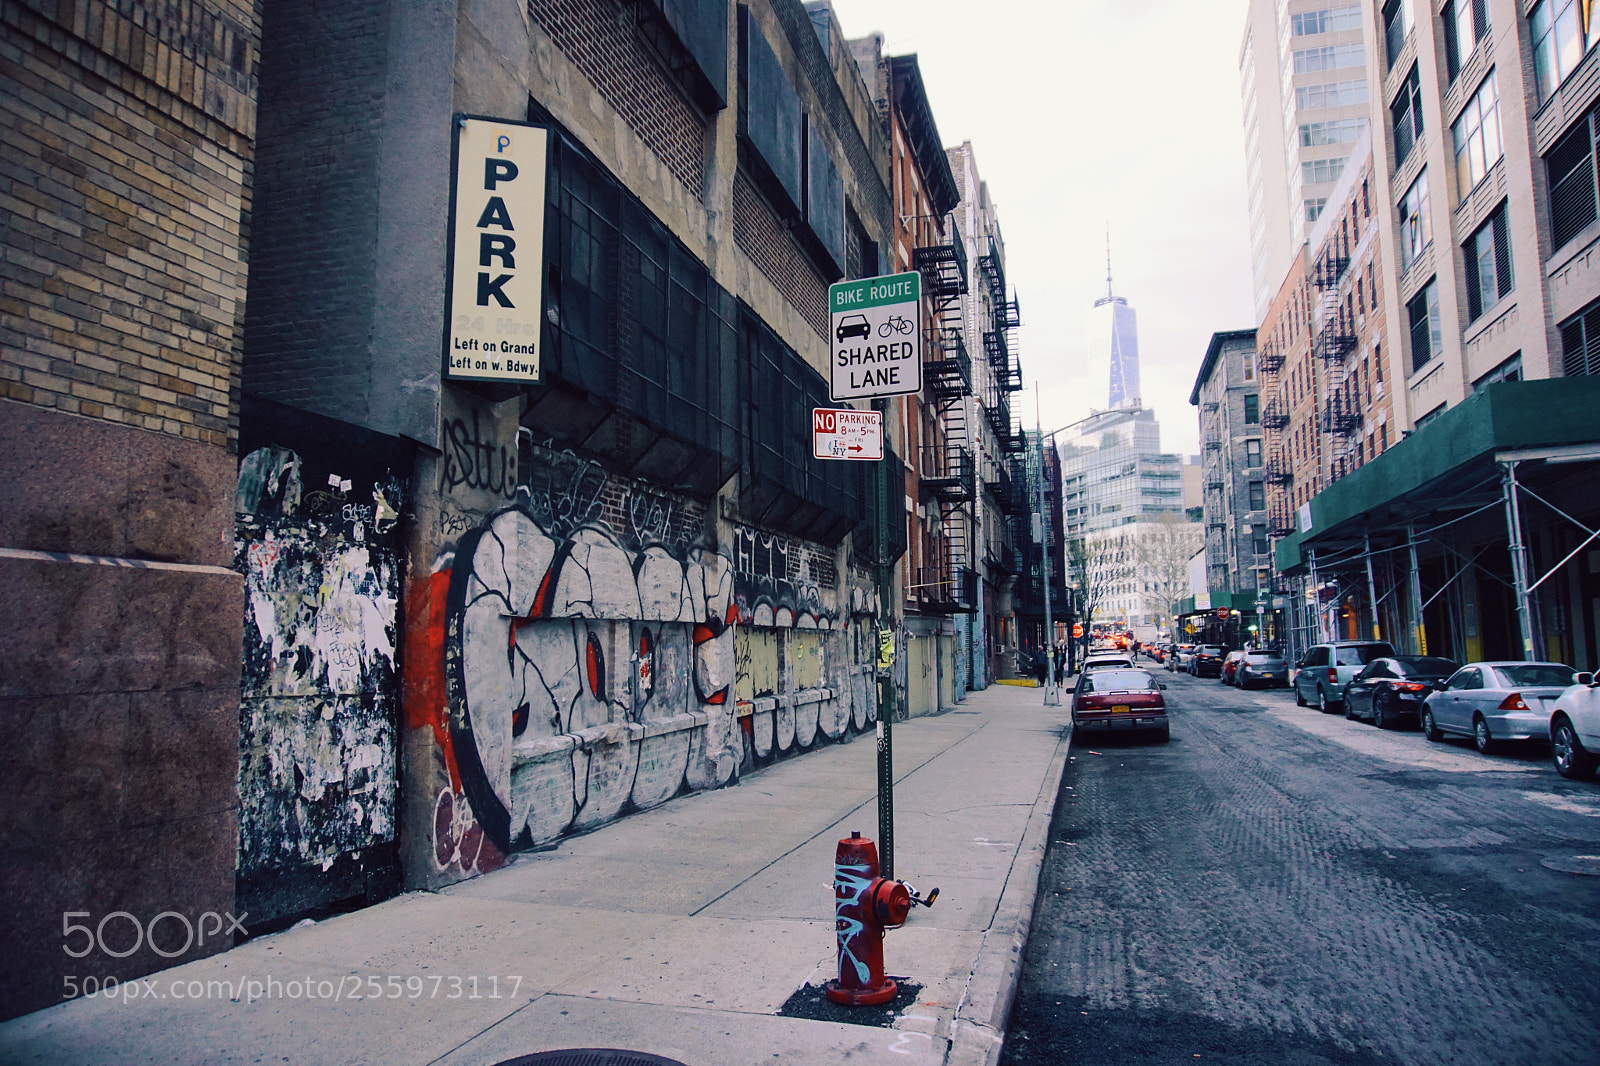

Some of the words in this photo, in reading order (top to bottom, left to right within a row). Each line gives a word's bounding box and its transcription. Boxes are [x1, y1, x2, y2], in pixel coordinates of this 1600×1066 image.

[476, 157, 518, 308] PARK
[836, 288, 864, 305] BIKE
[870, 281, 912, 300] ROUTE
[454, 337, 479, 351] Left
[483, 342, 497, 352] on
[501, 340, 535, 354] Grand
[837, 341, 914, 367] SHARED
[450, 356, 471, 369] Left
[475, 361, 487, 370] on
[507, 360, 538, 375] Bdwy.
[850, 367, 900, 389] LANE
[815, 413, 835, 430] NO
[840, 414, 877, 425] PARKING
[832, 447, 847, 456] NY
